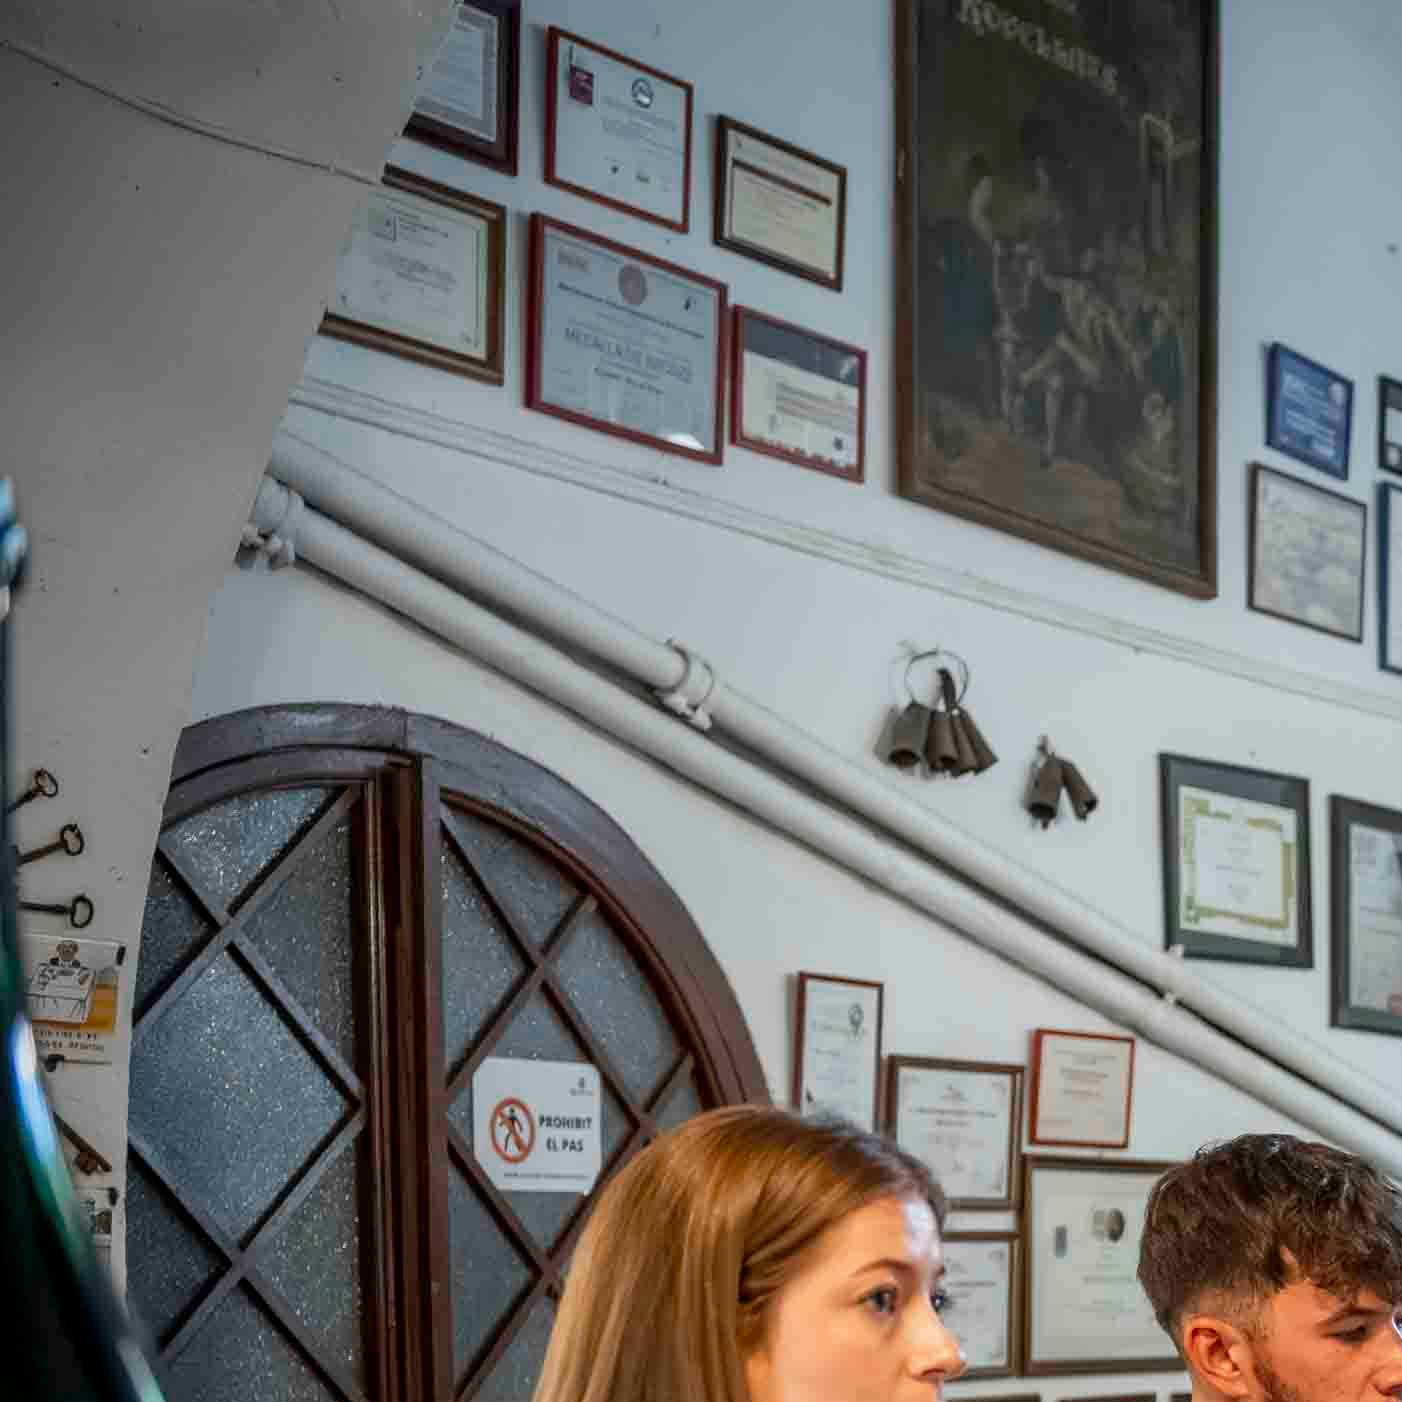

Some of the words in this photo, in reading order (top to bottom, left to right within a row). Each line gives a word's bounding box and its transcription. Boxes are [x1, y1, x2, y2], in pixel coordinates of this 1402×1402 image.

[538, 1116, 593, 1129] PROHIBIT
[546, 1138, 559, 1152] EL
[562, 1139, 585, 1152] PAS
